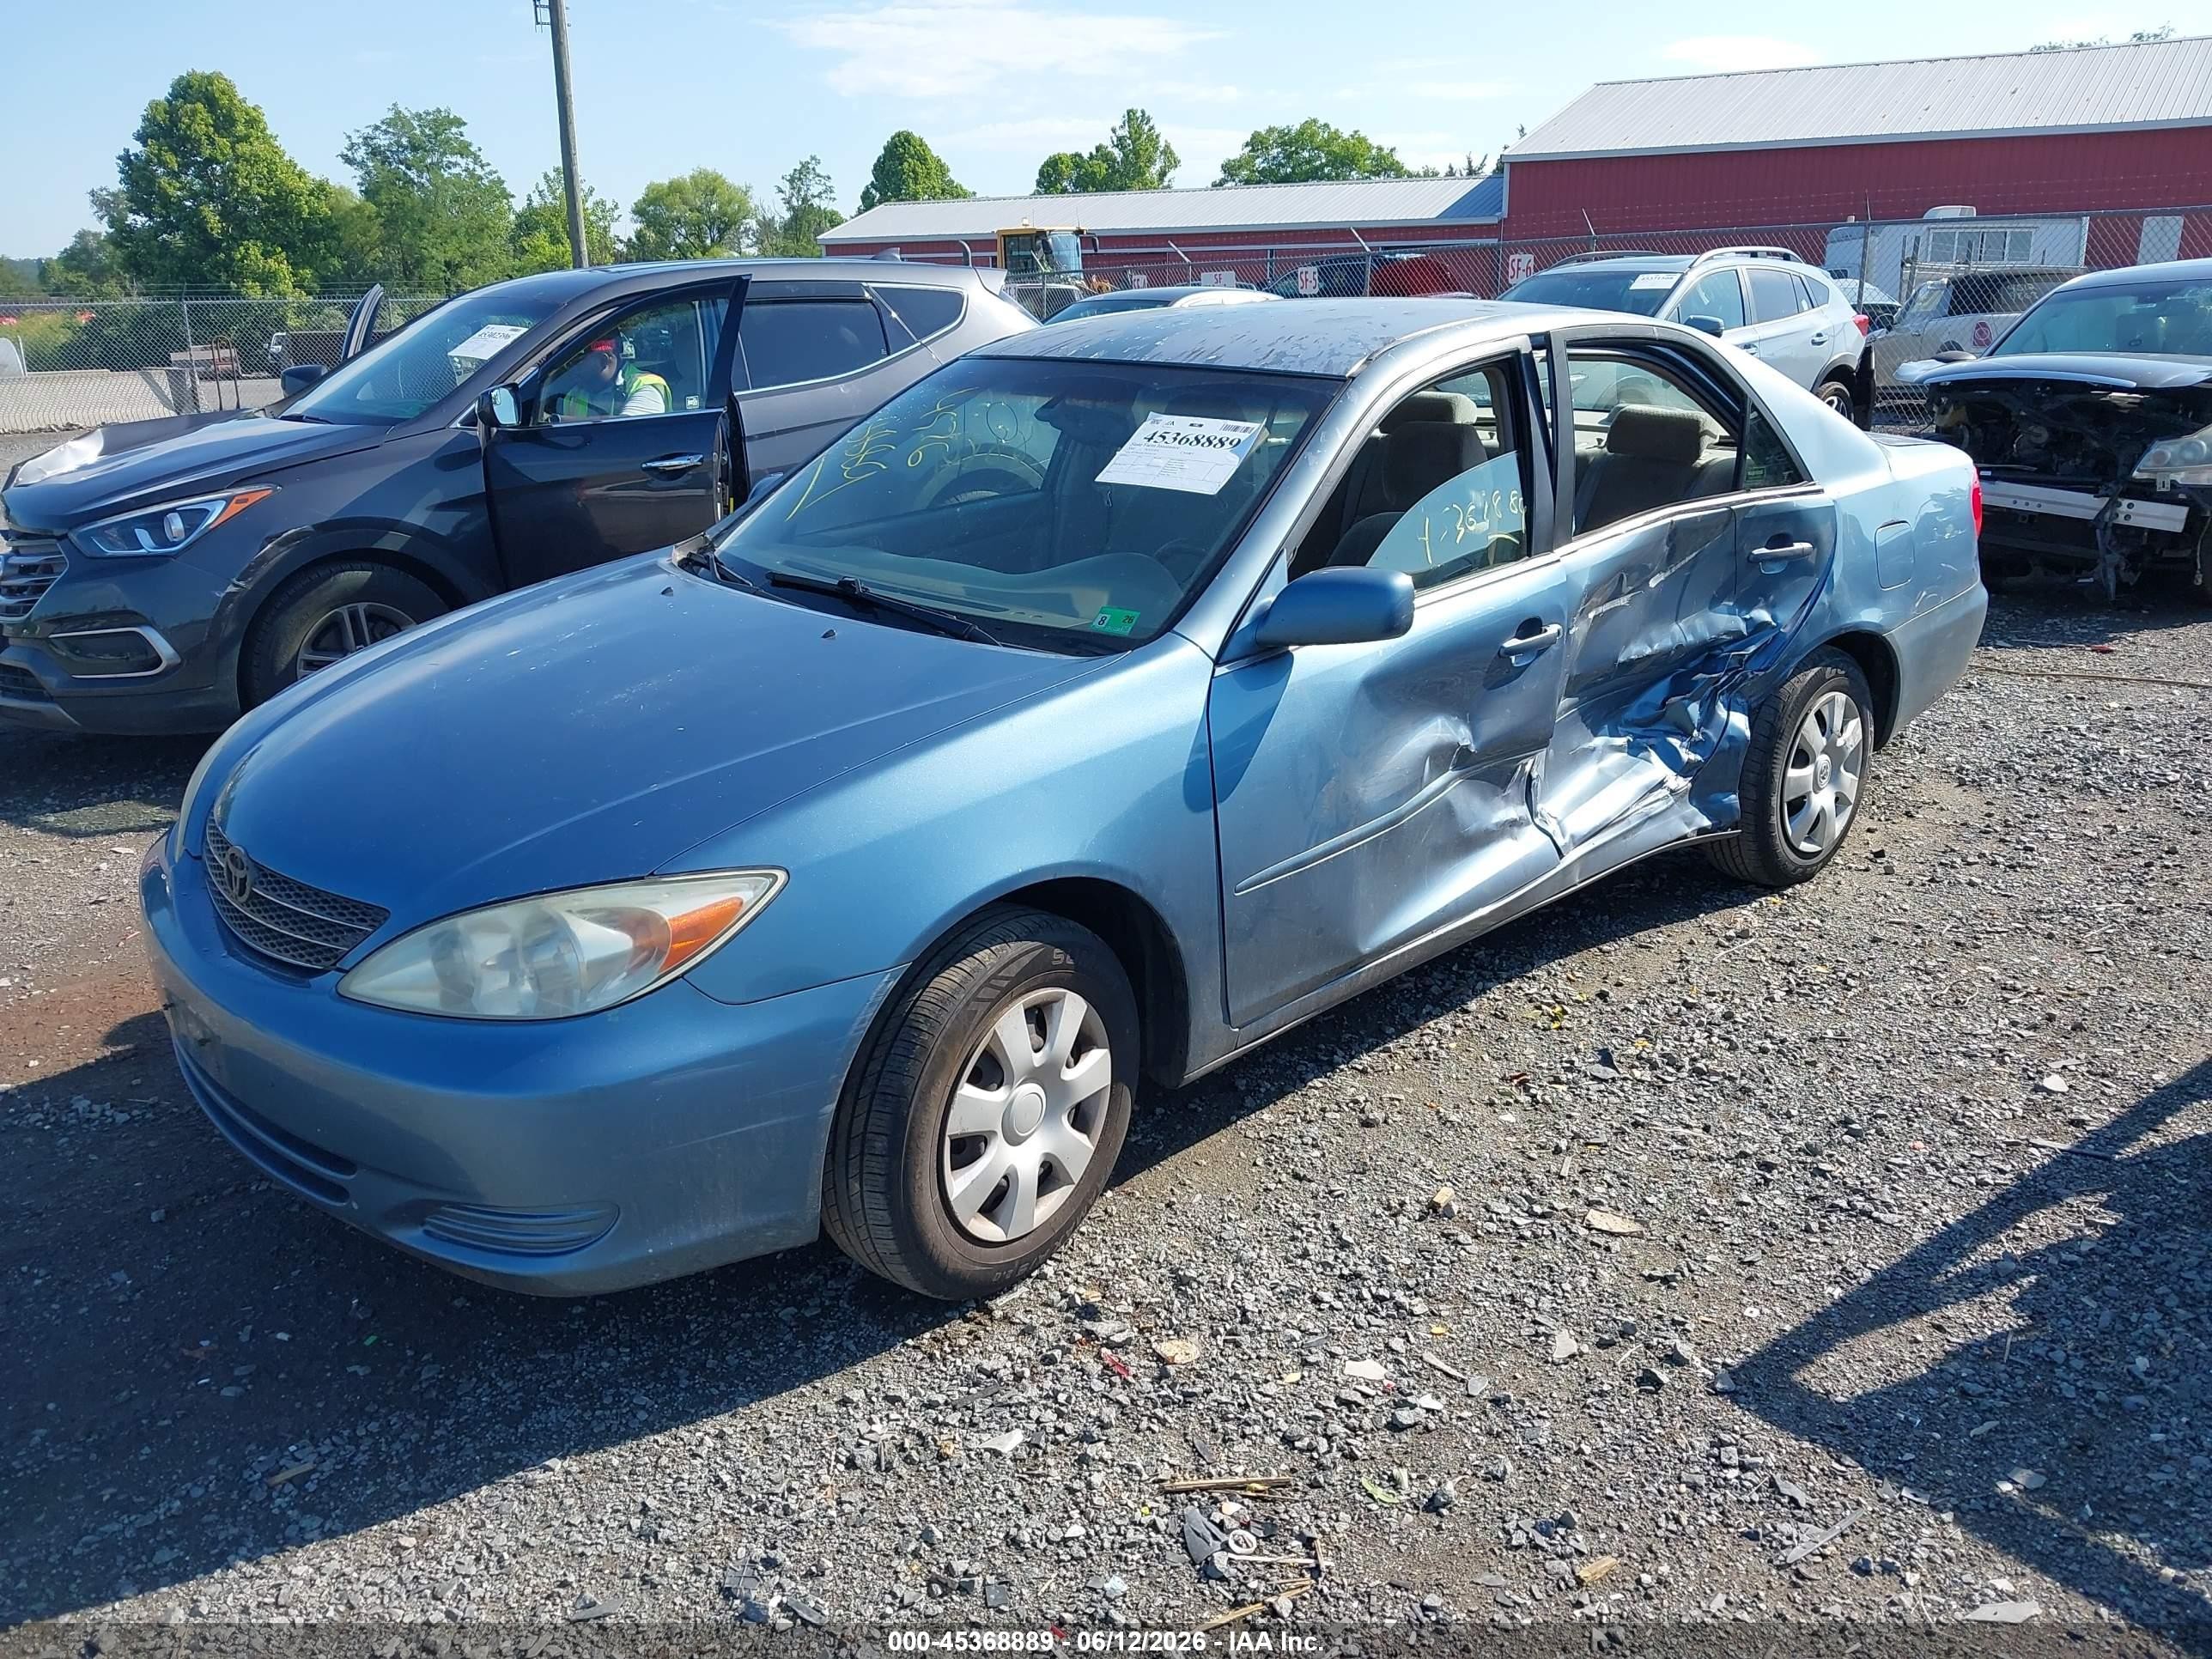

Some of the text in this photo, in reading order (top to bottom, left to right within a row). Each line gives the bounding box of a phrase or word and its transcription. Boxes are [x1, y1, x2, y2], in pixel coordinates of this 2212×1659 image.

[1213, 273, 1223, 284] SF
[1510, 258, 1532, 280] SF-6
[1299, 270, 1317, 289] SF-5
[1143, 430, 1242, 449] 45368889
[1097, 616, 1108, 625] 8
